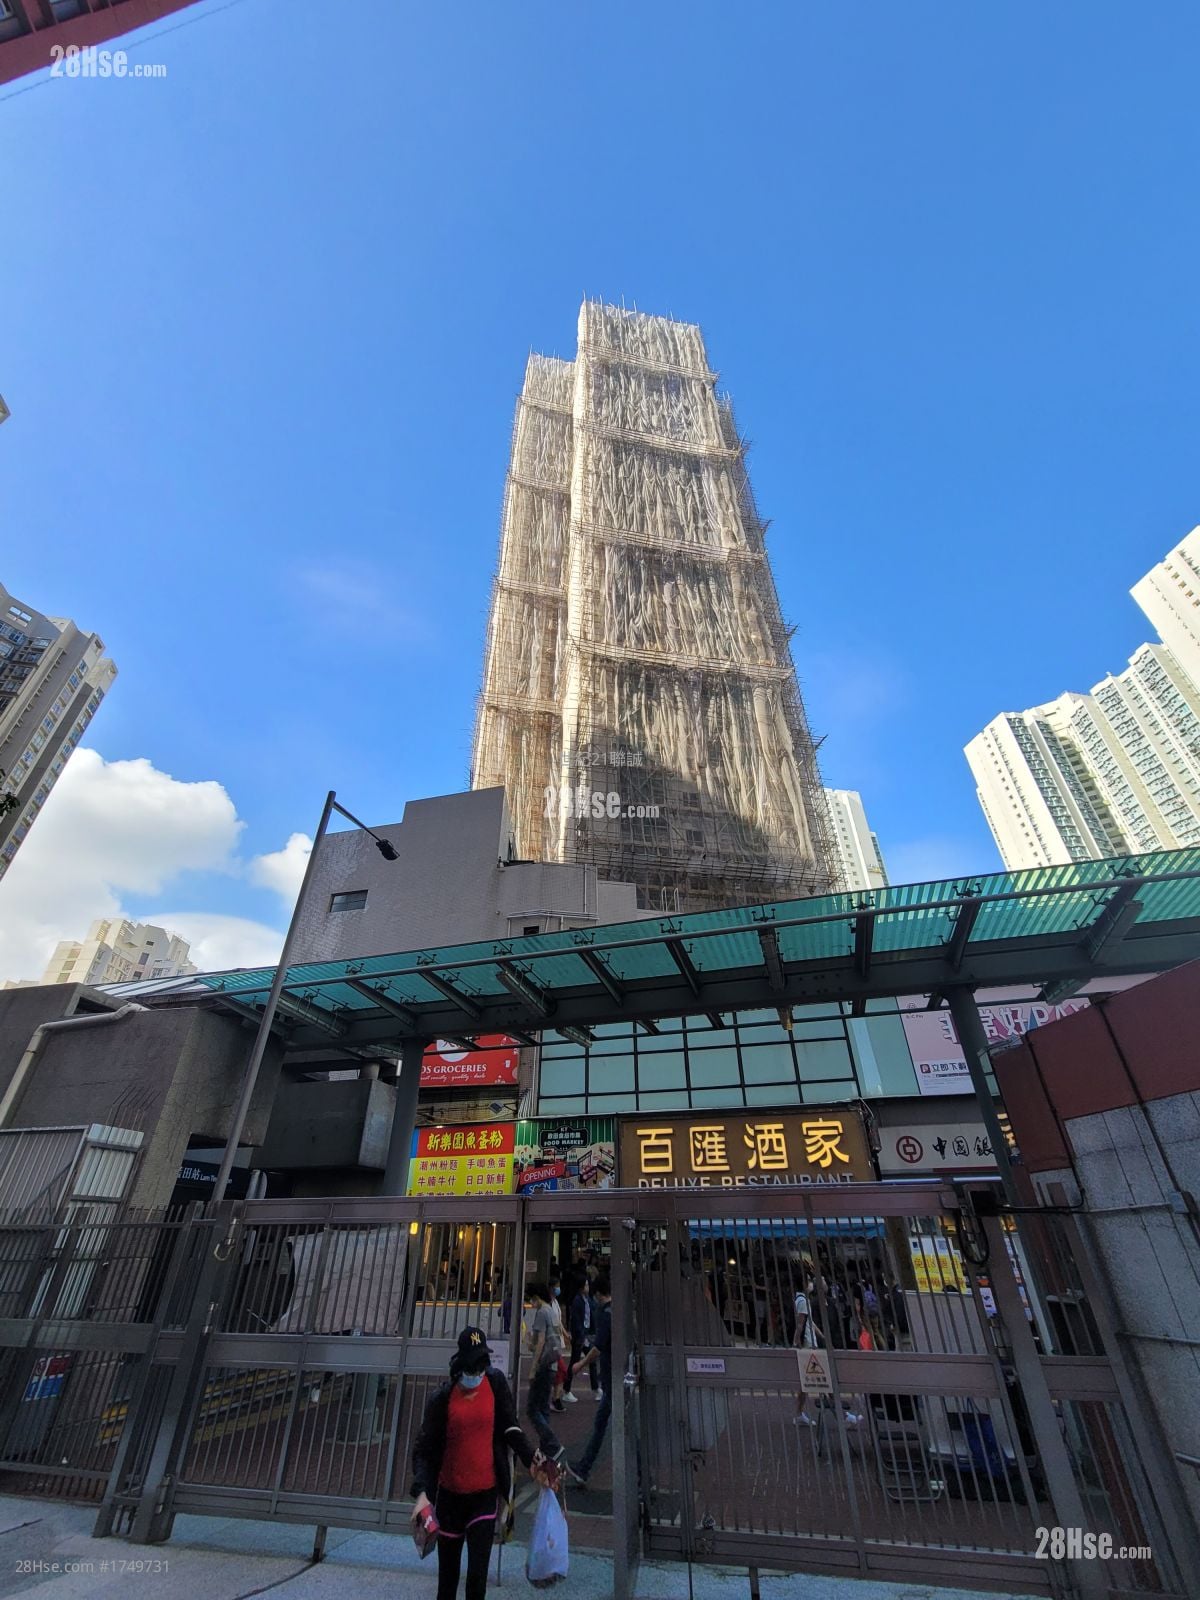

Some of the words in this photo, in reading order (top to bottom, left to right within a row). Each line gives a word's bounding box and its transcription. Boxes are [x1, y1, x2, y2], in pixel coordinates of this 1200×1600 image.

[433, 1063, 487, 1074] GROCERIES
[427, 1130, 504, 1152] 新樂園魚蛋粉
[636, 1118, 850, 1173] 百匯酒家
[466, 1174, 505, 1185] 日日新鮮
[523, 1167, 556, 1182] OPENING
[471, 1332, 481, 1345] NY
